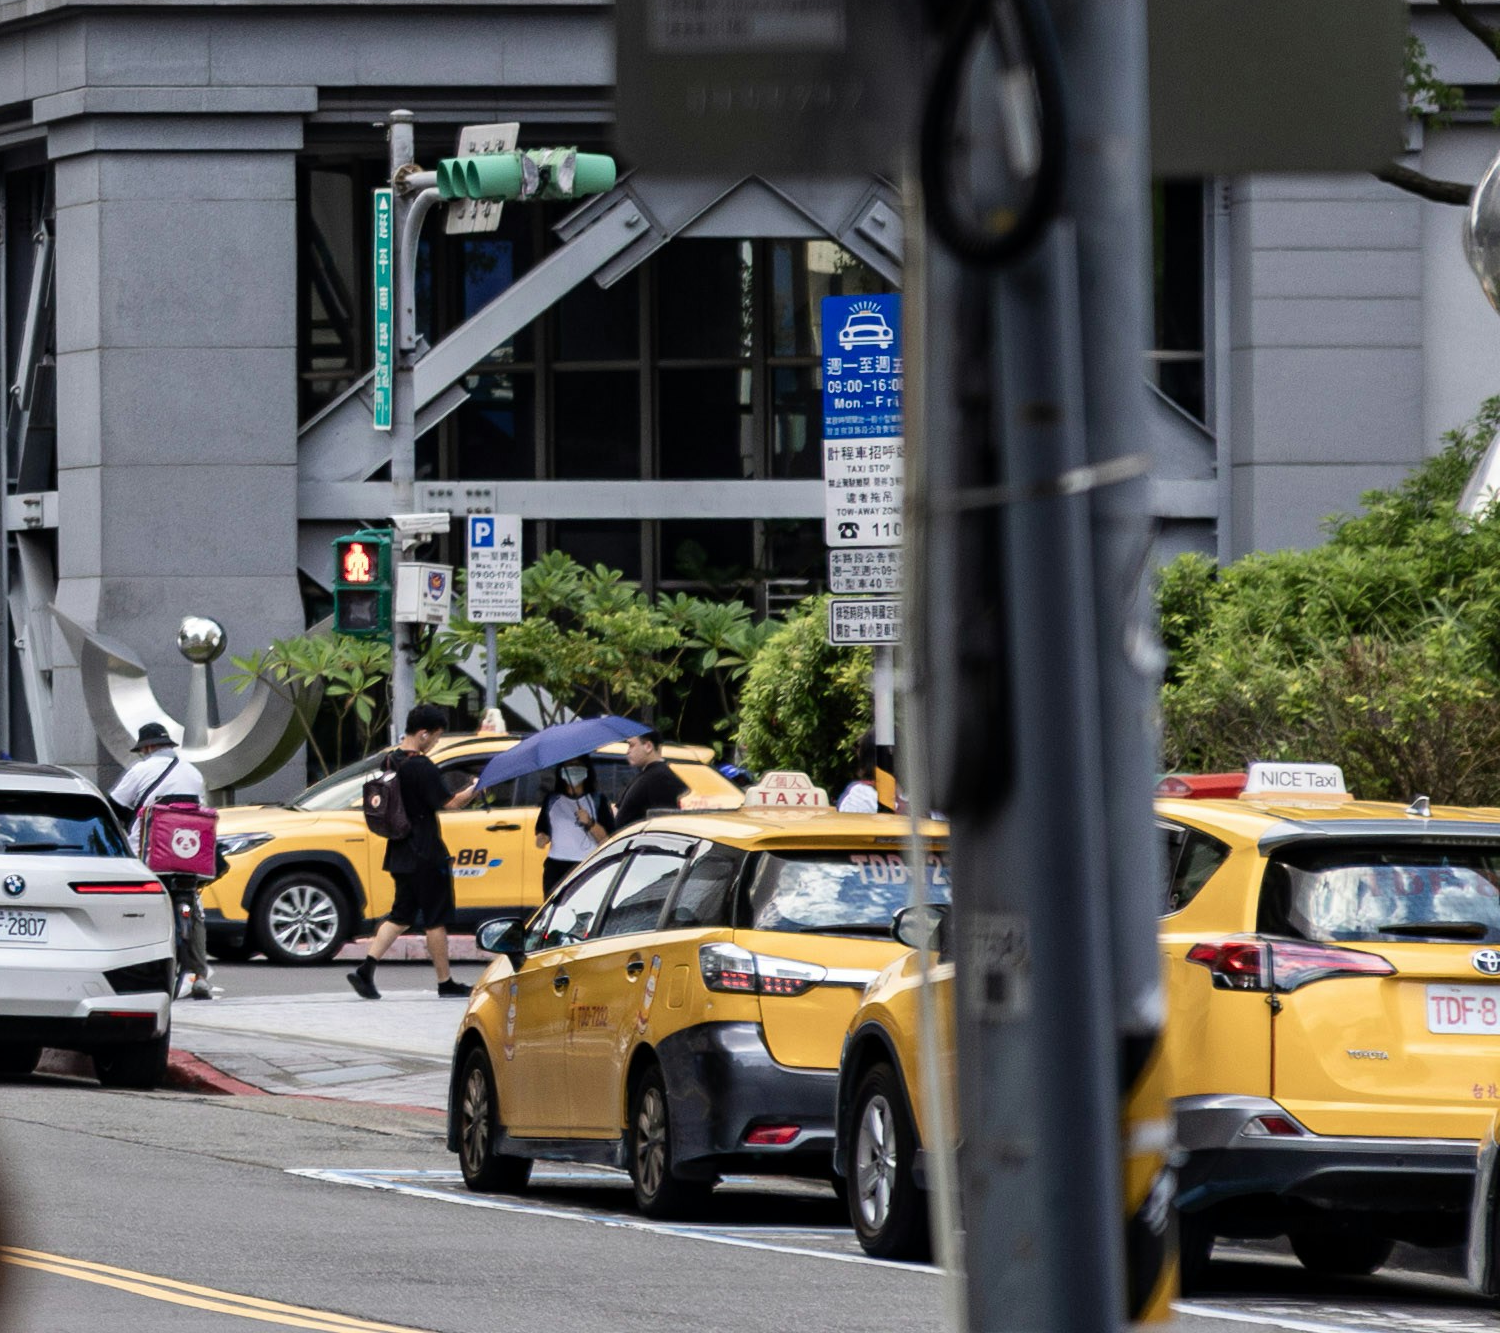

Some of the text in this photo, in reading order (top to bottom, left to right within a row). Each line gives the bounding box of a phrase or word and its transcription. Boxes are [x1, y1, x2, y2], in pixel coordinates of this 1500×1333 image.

[846, 464, 891, 473] TAXI STOP
[836, 507, 880, 516] TOW-AWAY
[1261, 771, 1337, 788] NICE Taxi
[758, 791, 819, 806] TAXI
[451, 848, 489, 866] 88
